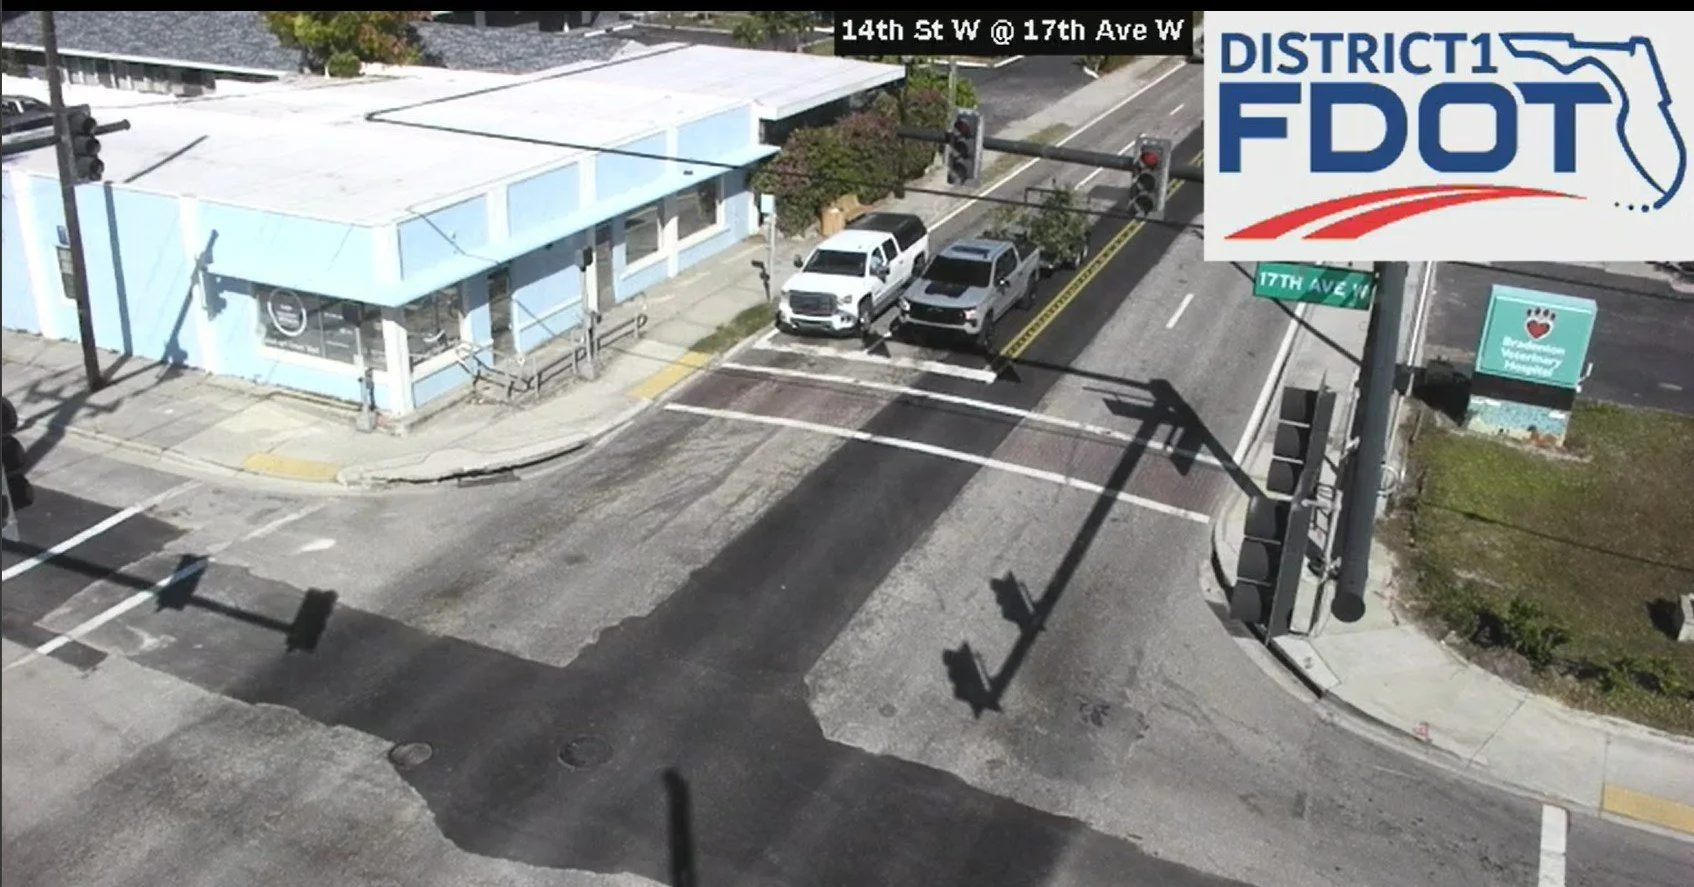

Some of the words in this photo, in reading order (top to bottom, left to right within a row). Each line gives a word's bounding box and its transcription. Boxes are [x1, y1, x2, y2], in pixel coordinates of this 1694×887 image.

[1259, 271, 1304, 291] 17TH
[1308, 277, 1346, 297] AVE
[1502, 336, 1566, 356] Bradenton
[1501, 347, 1563, 369] Veterinary
[1504, 360, 1553, 377] Hospital
